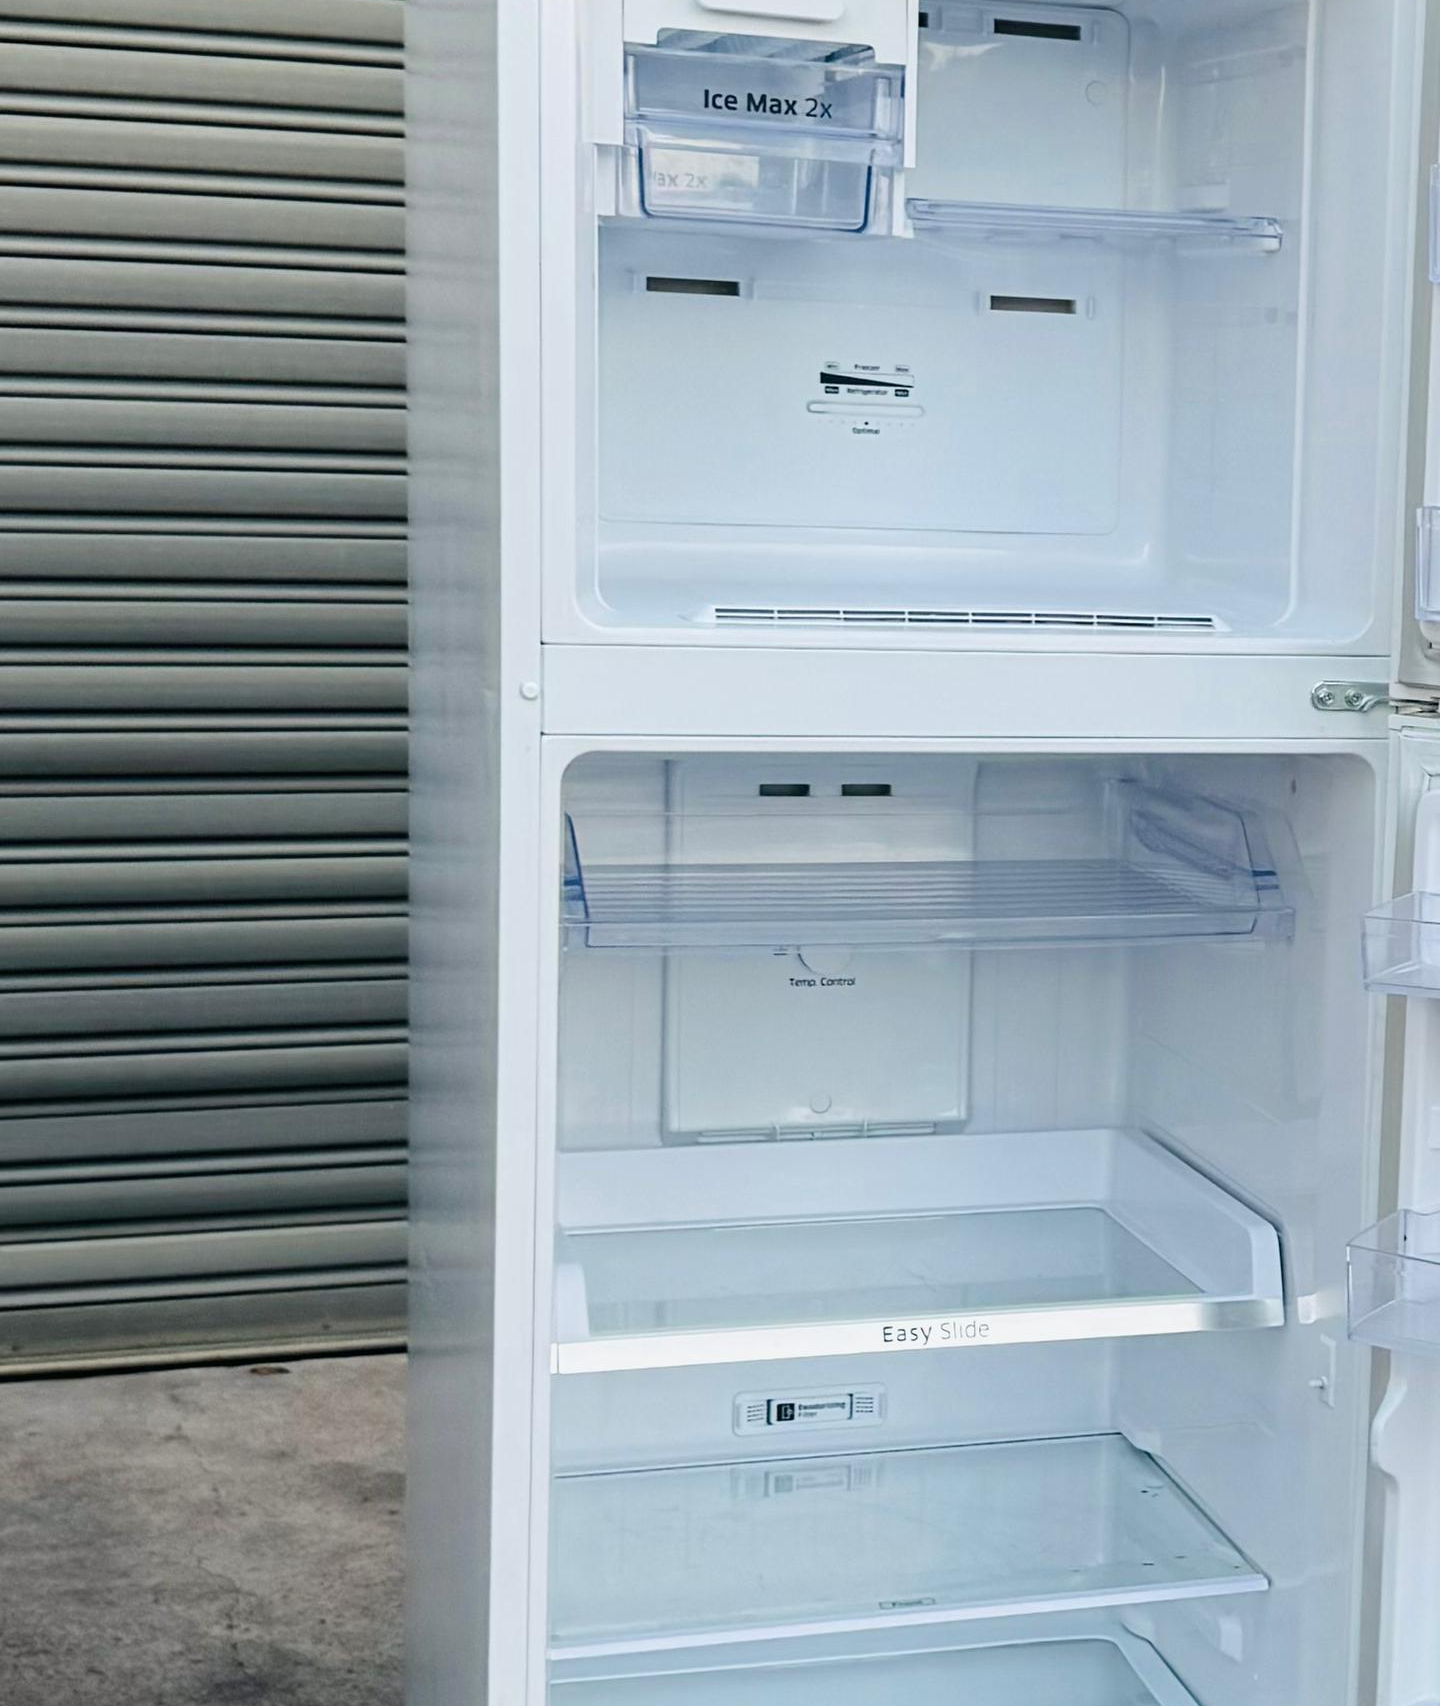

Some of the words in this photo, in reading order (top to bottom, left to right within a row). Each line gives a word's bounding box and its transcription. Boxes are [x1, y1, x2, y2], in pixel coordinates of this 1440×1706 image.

[703, 89, 738, 111] Ice
[746, 92, 797, 116] Max
[805, 98, 833, 119] 2x
[789, 977, 817, 987] Temp.
[820, 977, 856, 987] Control
[882, 1326, 932, 1345] Easy
[940, 1320, 989, 1340] Slide
